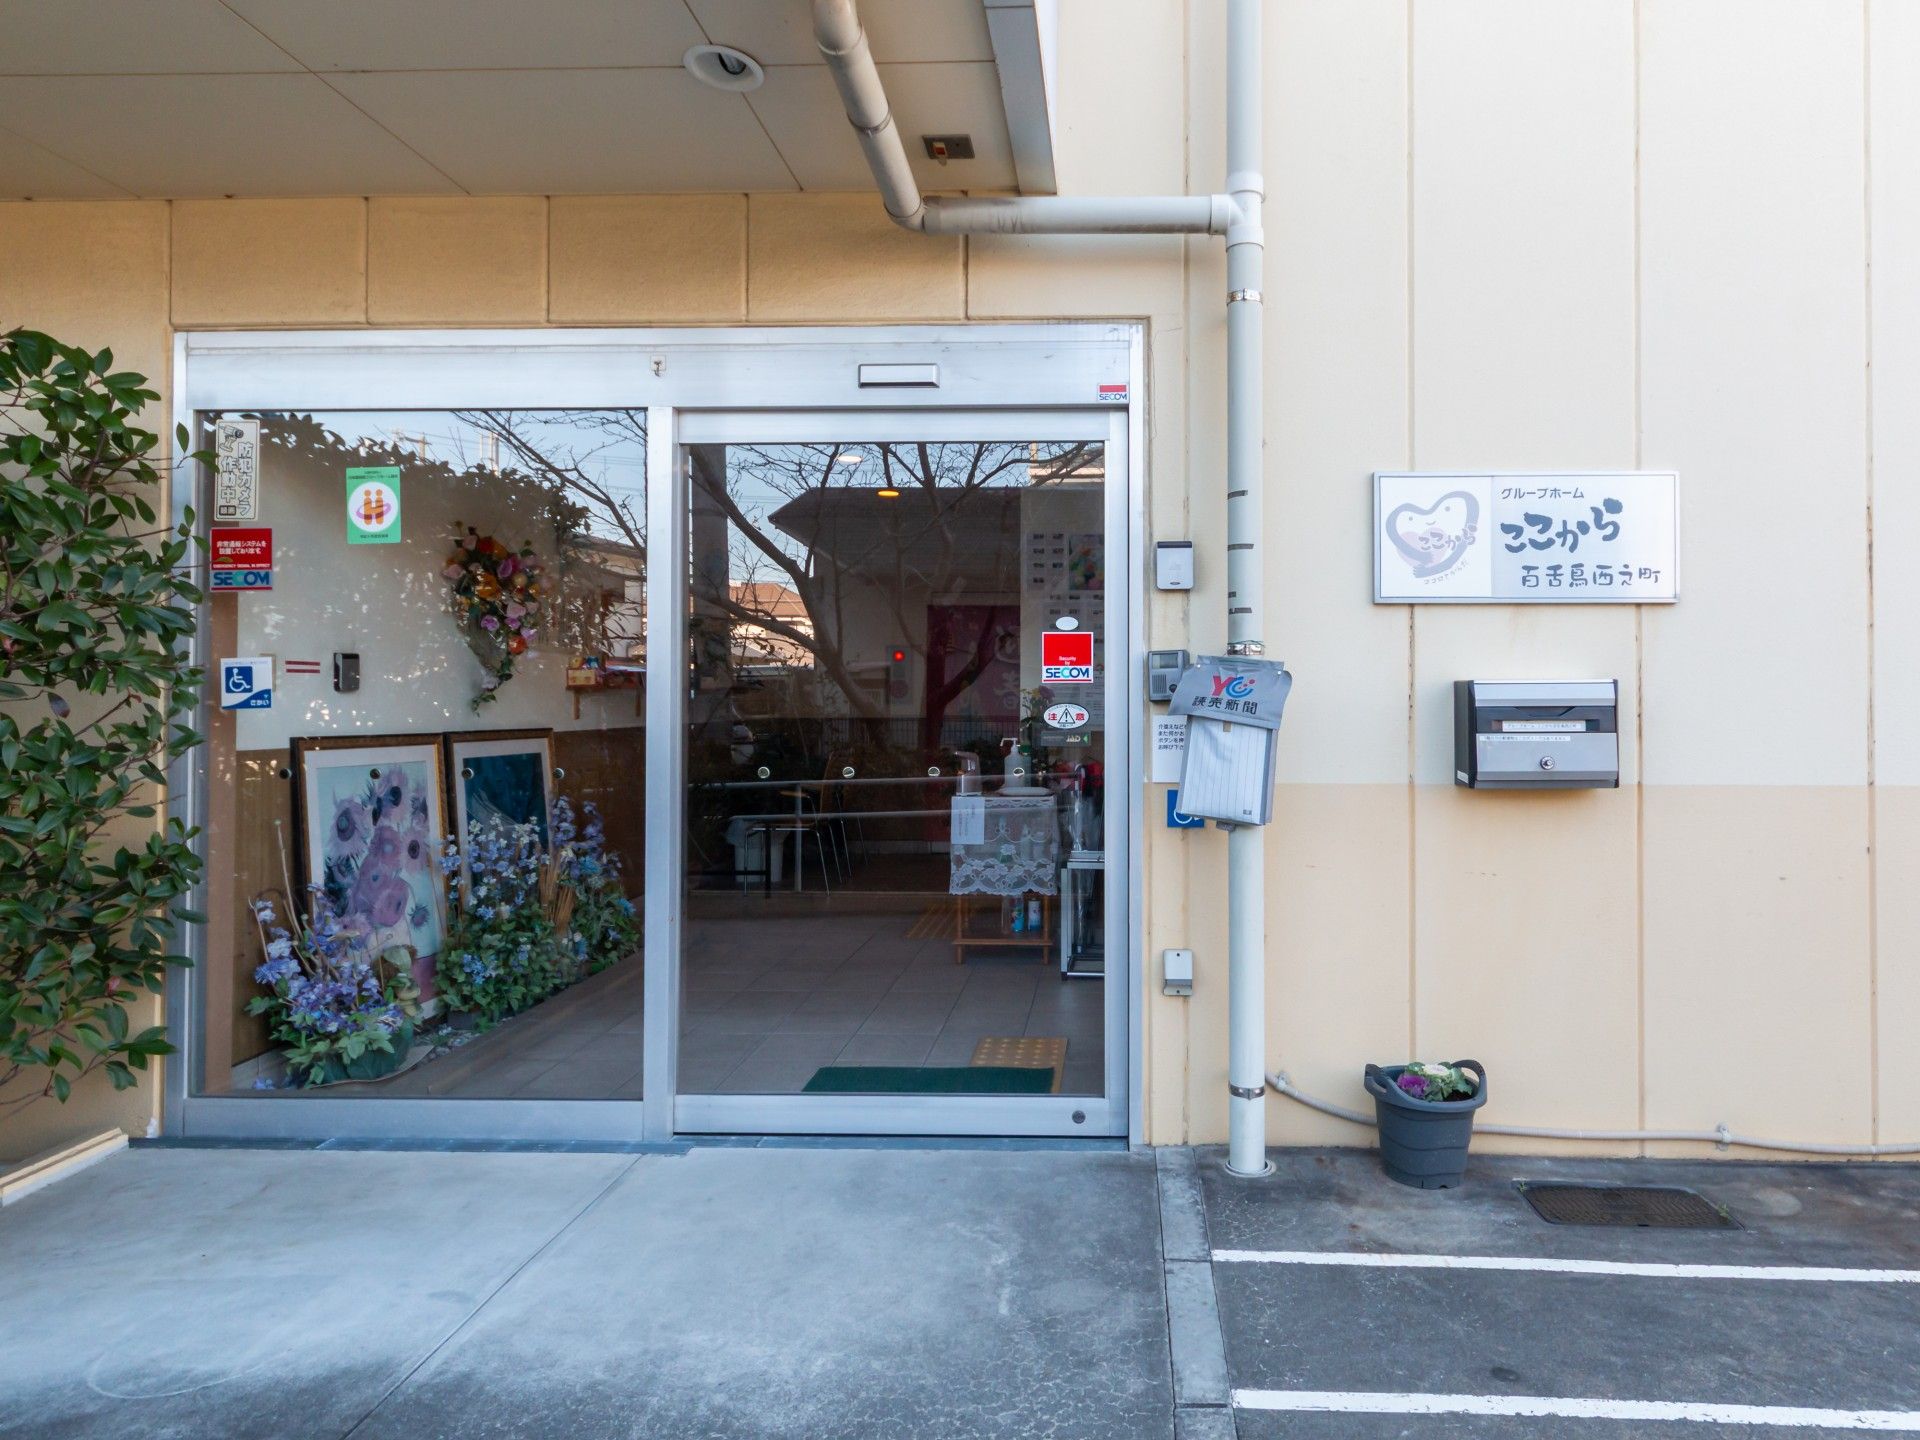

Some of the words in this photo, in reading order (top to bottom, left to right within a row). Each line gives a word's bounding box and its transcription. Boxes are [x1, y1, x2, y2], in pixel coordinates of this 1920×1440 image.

[1099, 393, 1127, 401] SECOM
[219, 456, 237, 503] 作動中
[237, 441, 254, 516] 防犯カメラ
[1501, 487, 1585, 500] グループホーム
[1500, 497, 1624, 554] ここから
[1418, 523, 1477, 551] ここから
[213, 570, 270, 586] SECOM
[1521, 562, 1661, 588] 百舌鳥西之町
[1046, 667, 1090, 678] SECOM
[1191, 696, 1258, 715] 読売新聞
